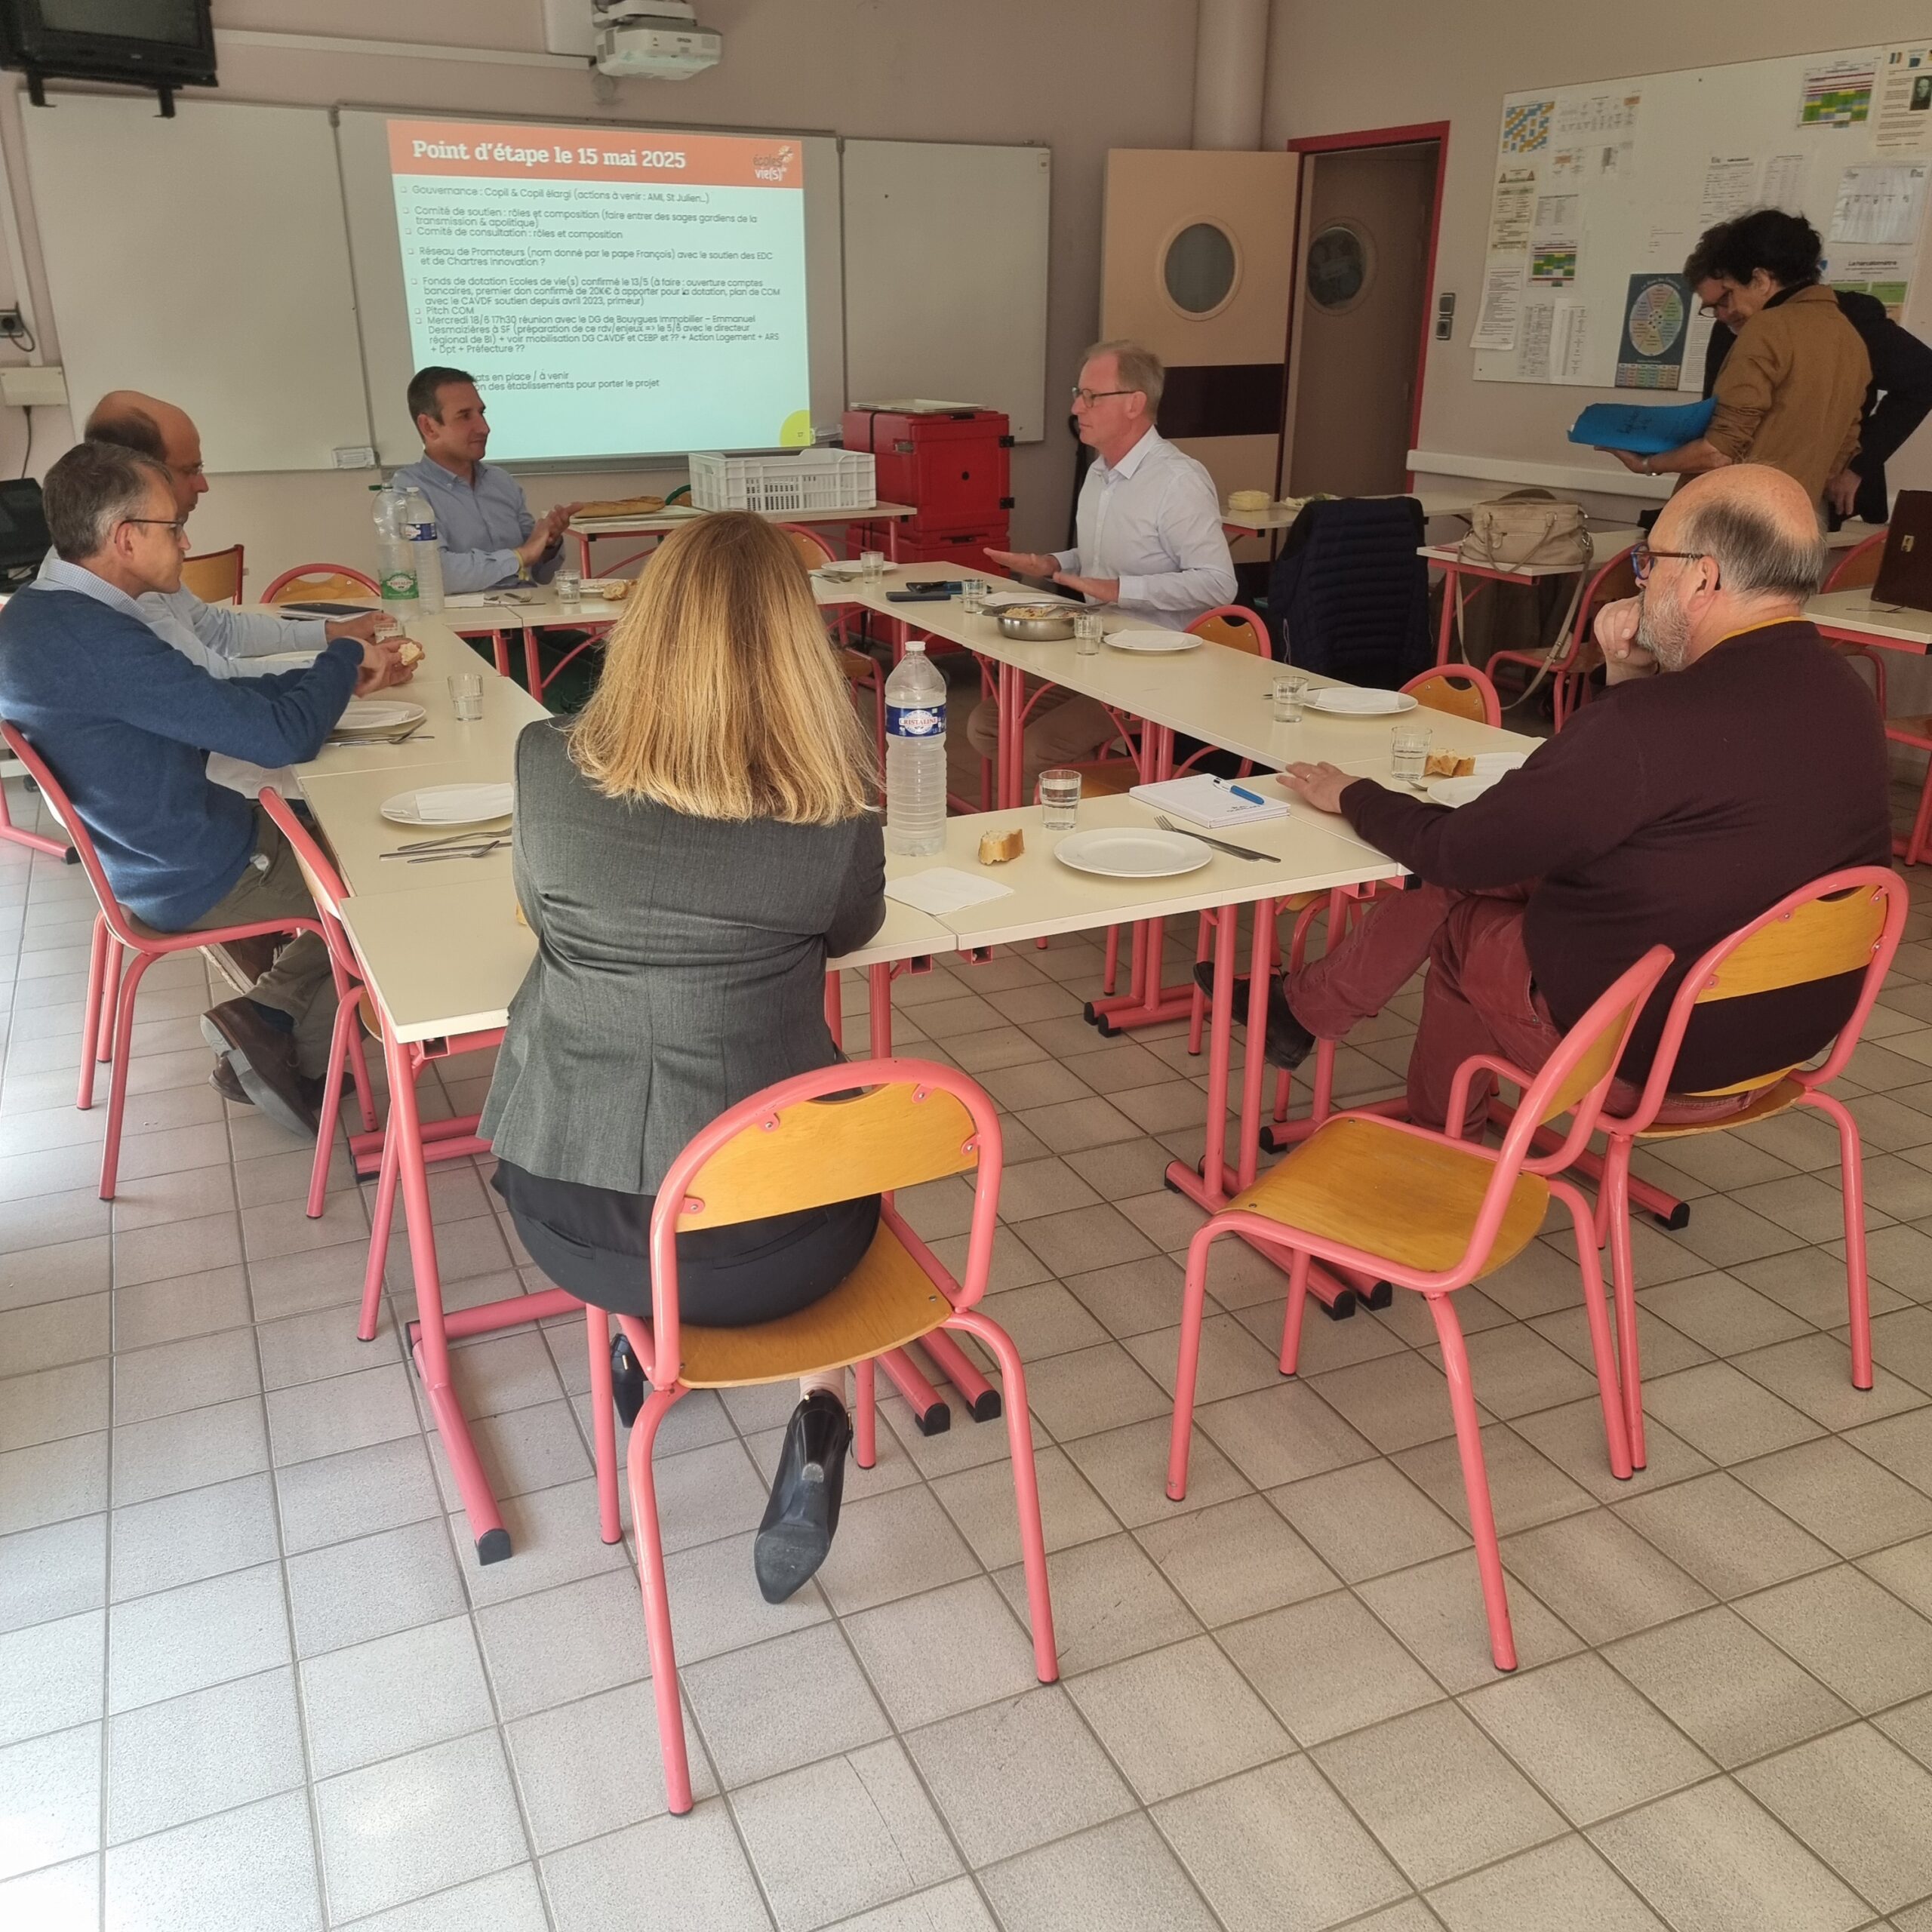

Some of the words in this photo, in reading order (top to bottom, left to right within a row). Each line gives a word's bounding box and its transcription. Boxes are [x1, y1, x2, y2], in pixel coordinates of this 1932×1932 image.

[412, 140, 470, 159] Point
[475, 143, 549, 167] d'étape
[554, 146, 573, 163] le
[577, 148, 598, 165] 15
[603, 149, 638, 166] mai
[641, 150, 685, 168] 2025
[412, 186, 478, 195] Gouvernance
[484, 188, 510, 198] Copil
[520, 189, 543, 198] Copil
[546, 189, 571, 200] élargi
[574, 189, 610, 200] (actions
[612, 190, 618, 199] à
[621, 192, 641, 200] venir
[666, 193, 674, 202] St
[415, 206, 451, 216] Comité
[452, 208, 464, 216] de
[467, 208, 501, 217] soutien
[509, 208, 530, 217] rôles
[544, 210, 599, 220] composition
[601, 209, 624, 220] (faire
[627, 211, 652, 220] entrer
[654, 212, 669, 220] des
[672, 214, 697, 223] sages
[699, 213, 735, 223] gardiens
[737, 214, 747, 223] de
[416, 217, 478, 226] transmission
[488, 216, 539, 229] apolitique)
[417, 226, 452, 236] Comité
[454, 228, 467, 236] de
[469, 228, 527, 237] consultation
[534, 229, 555, 238] rôles
[568, 229, 623, 240] composition
[419, 247, 454, 255] Réseau
[457, 248, 469, 256] de
[471, 248, 525, 256] Promoteurs
[528, 246, 552, 258] (nom
[554, 248, 583, 257] donné
[585, 250, 600, 259] par
[612, 251, 635, 260] pape
[636, 248, 675, 260] François)
[677, 251, 697, 259] avec
[709, 251, 739, 260] soutien
[741, 251, 755, 260] des
[420, 257, 430, 265] et
[432, 257, 445, 265] de
[447, 257, 488, 266] Chartres
[491, 258, 538, 266] Innovation
[423, 276, 451, 285] Fonds
[454, 277, 466, 285] de
[468, 277, 507, 286] dotation
[509, 278, 538, 286] Ecoles
[540, 278, 552, 286] de
[554, 275, 578, 287] vie(s)
[581, 278, 620, 286] confirmé
[622, 278, 629, 286] le
[631, 276, 648, 288] 13/5
[651, 276, 660, 288] (à
[662, 278, 680, 286] faire
[686, 278, 725, 287] ouverture
[728, 279, 763, 288] comptes
[423, 287, 473, 296] bancaires,
[475, 287, 512, 297] premier
[515, 287, 531, 295] don
[534, 286, 574, 295] confirmé
[614, 288, 620, 296] à
[622, 288, 659, 297] apporter
[691, 288, 728, 297] dotation,
[729, 288, 747, 297] plan
[425, 297, 448, 306] avec
[461, 297, 491, 305] CAVDF
[494, 297, 528, 305] soutien
[530, 297, 559, 307] depuis
[561, 297, 580, 305] avril
[583, 297, 605, 306] 2023,
[608, 295, 645, 307] primeur)
[426, 306, 449, 315] Pitch
[452, 306, 474, 315] COM
[427, 315, 468, 325] Mercredi
[518, 315, 552, 324] réunion
[555, 315, 577, 324] avec
[617, 315, 658, 325] Bouygues
[659, 315, 703, 323] Immobilier
[712, 315, 755, 323] Emmanuel
[429, 325, 490, 334] Desmaizières
[513, 323, 570, 335] (préparation
[598, 323, 642, 334] rdv/enjeux
[429, 336, 468, 346] régional
[525, 334, 580, 343] mobilisation
[689, 333, 715, 341] Action
[716, 334, 756, 343] Logement
[439, 345, 456, 355] Dpt
[466, 344, 513, 352] Préfecture
[515, 344, 525, 352] ??
[506, 373, 531, 383] place
[540, 371, 546, 380] à
[548, 372, 568, 380] venir
[488, 382, 505, 390] des
[507, 380, 574, 389] établissements
[577, 381, 595, 391] pour
[598, 380, 623, 389] porter
[635, 380, 660, 389] projet
